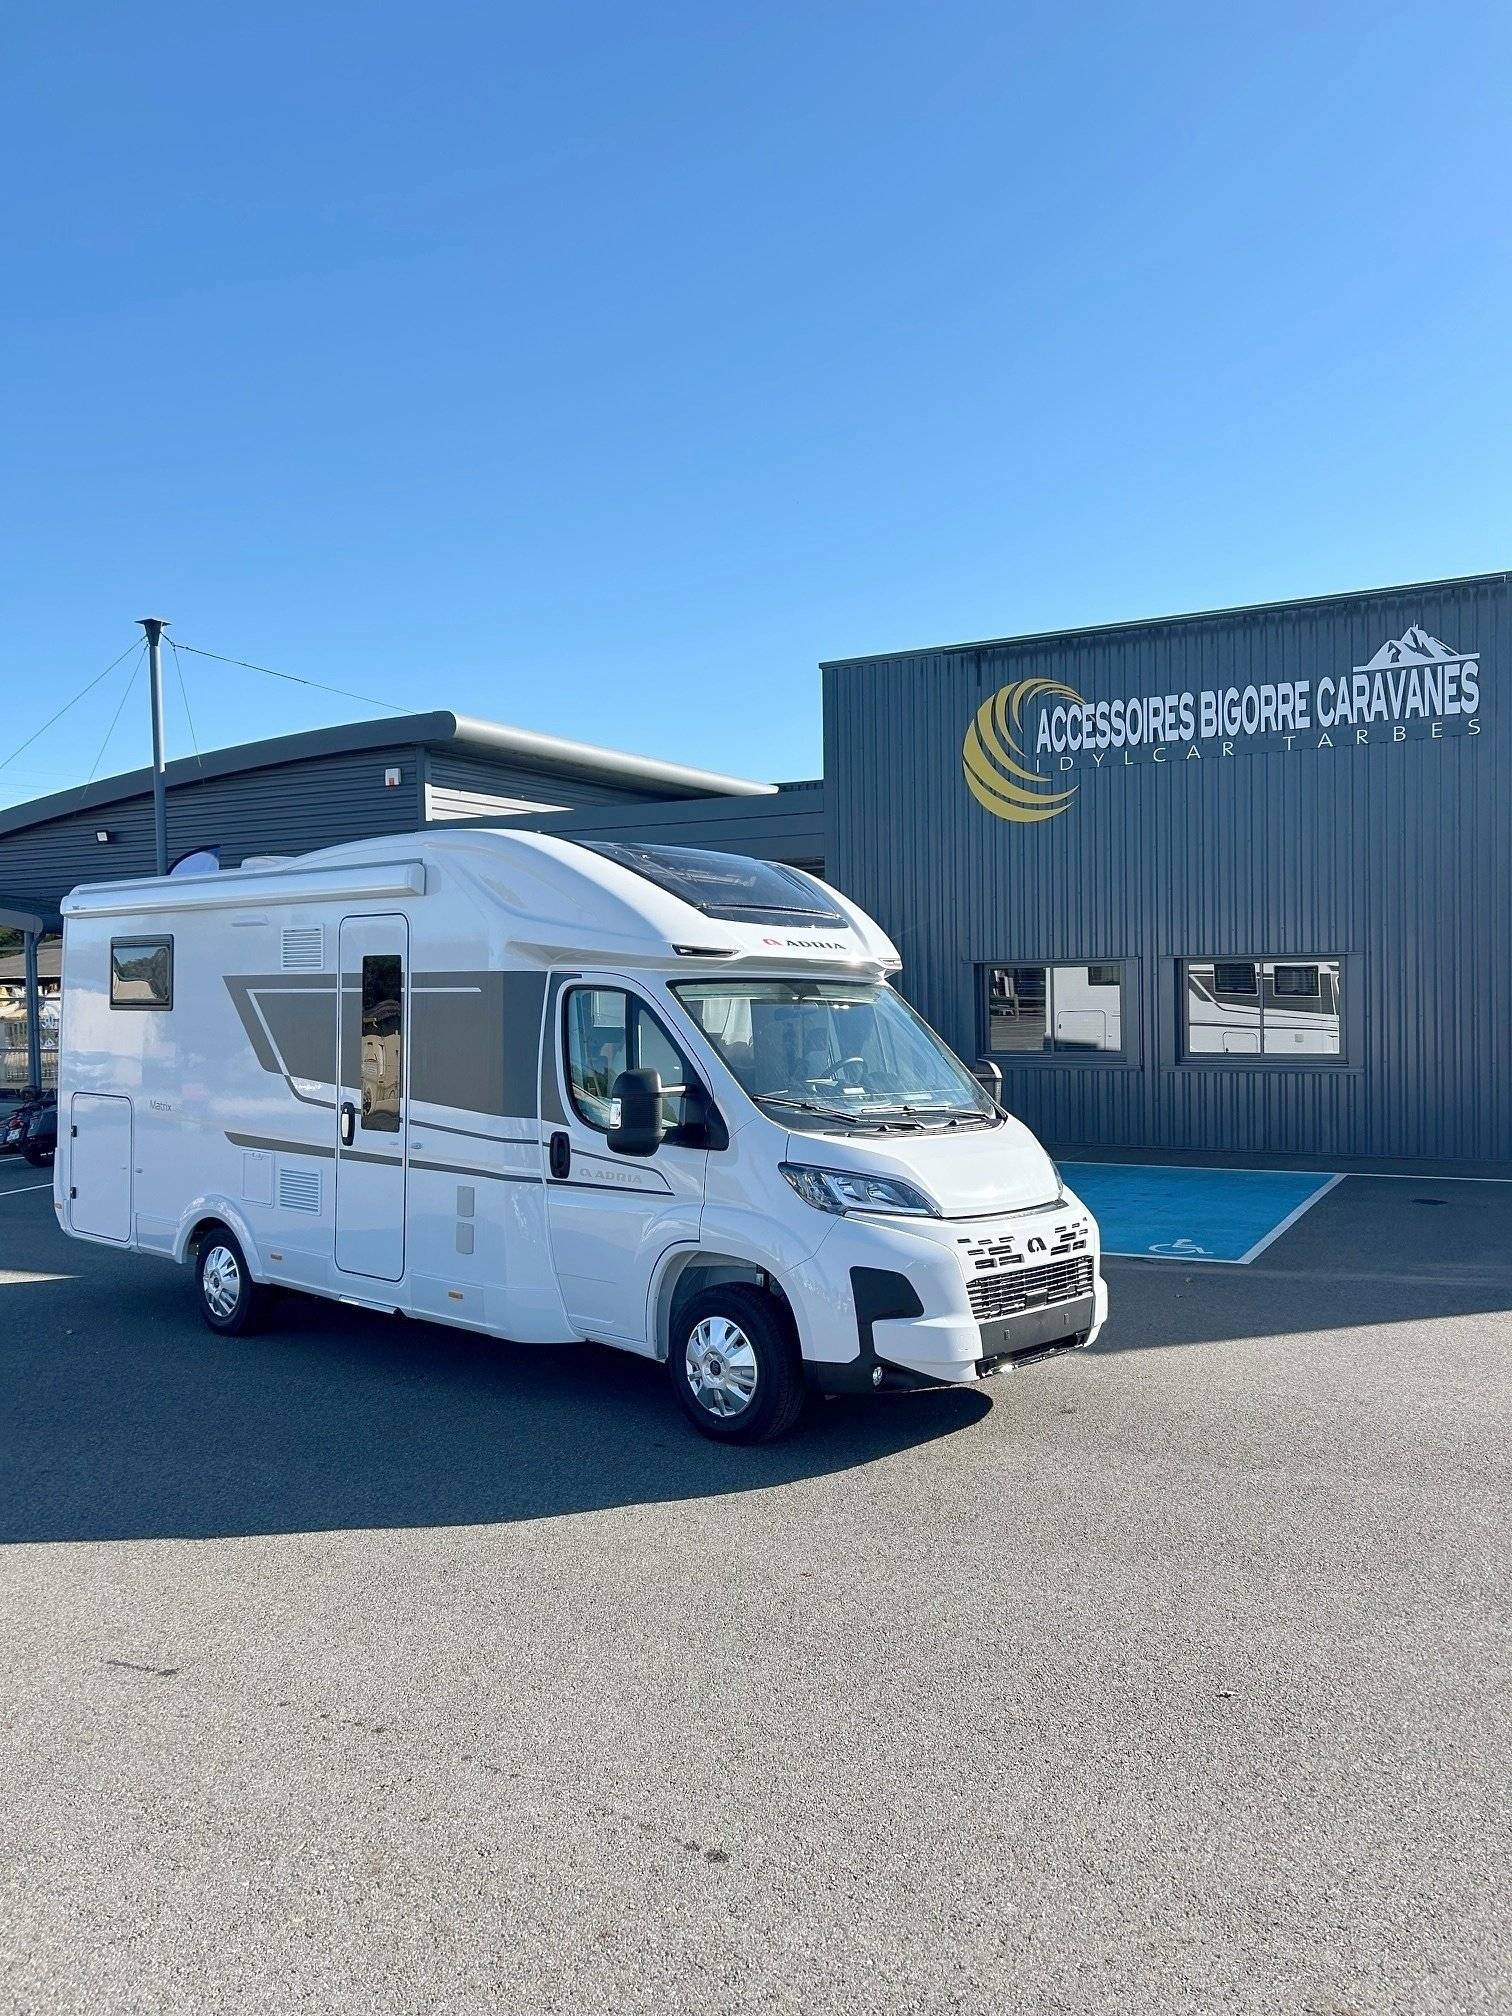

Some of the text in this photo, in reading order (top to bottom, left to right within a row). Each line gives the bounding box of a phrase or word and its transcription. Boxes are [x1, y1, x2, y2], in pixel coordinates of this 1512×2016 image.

[1036, 661, 1480, 753] ACCESSOIRES BIGORRE CARAVANES
[1036, 718, 1481, 773] IDYLCAR TARBES
[786, 939, 847, 950] ADRIA
[595, 1170, 643, 1184] ADRIA
